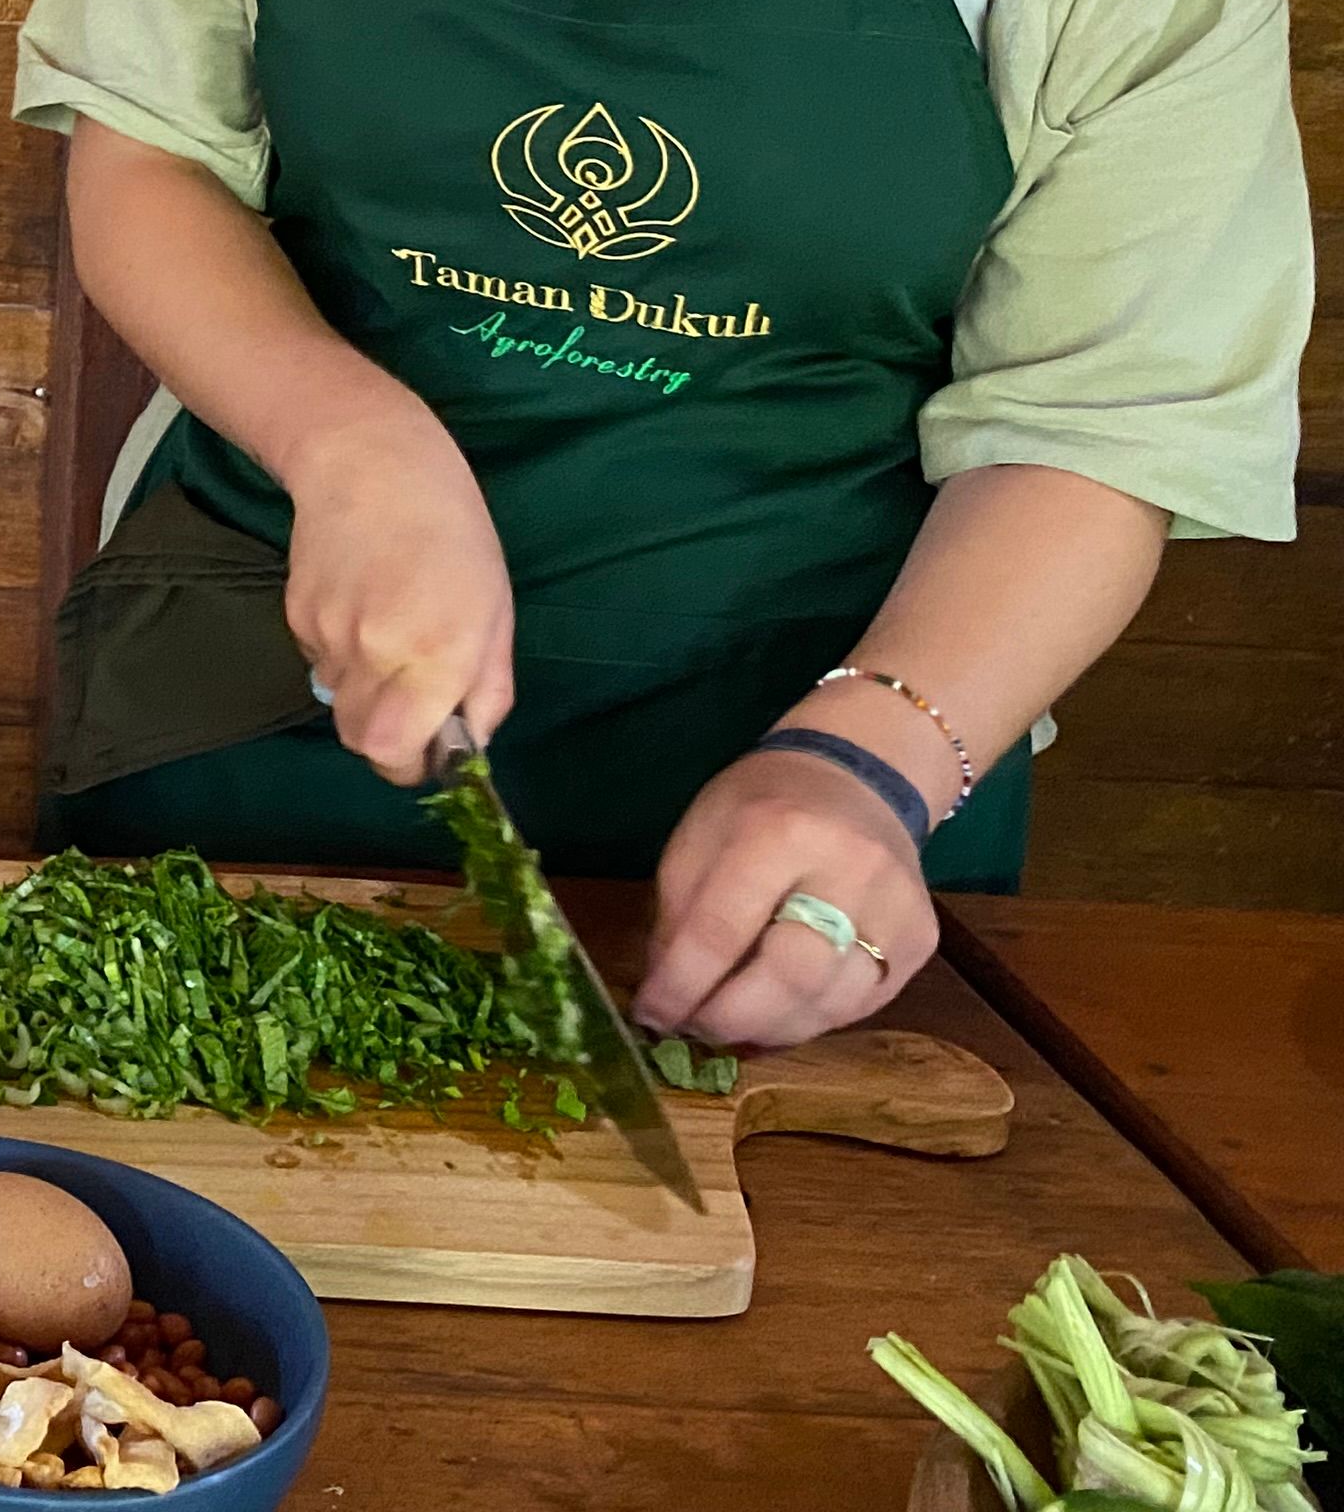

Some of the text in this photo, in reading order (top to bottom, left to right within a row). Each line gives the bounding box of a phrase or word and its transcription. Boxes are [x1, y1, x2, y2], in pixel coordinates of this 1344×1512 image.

[391, 248, 772, 338] Taman Dukuh
[449, 311, 692, 394] Agroforestry
